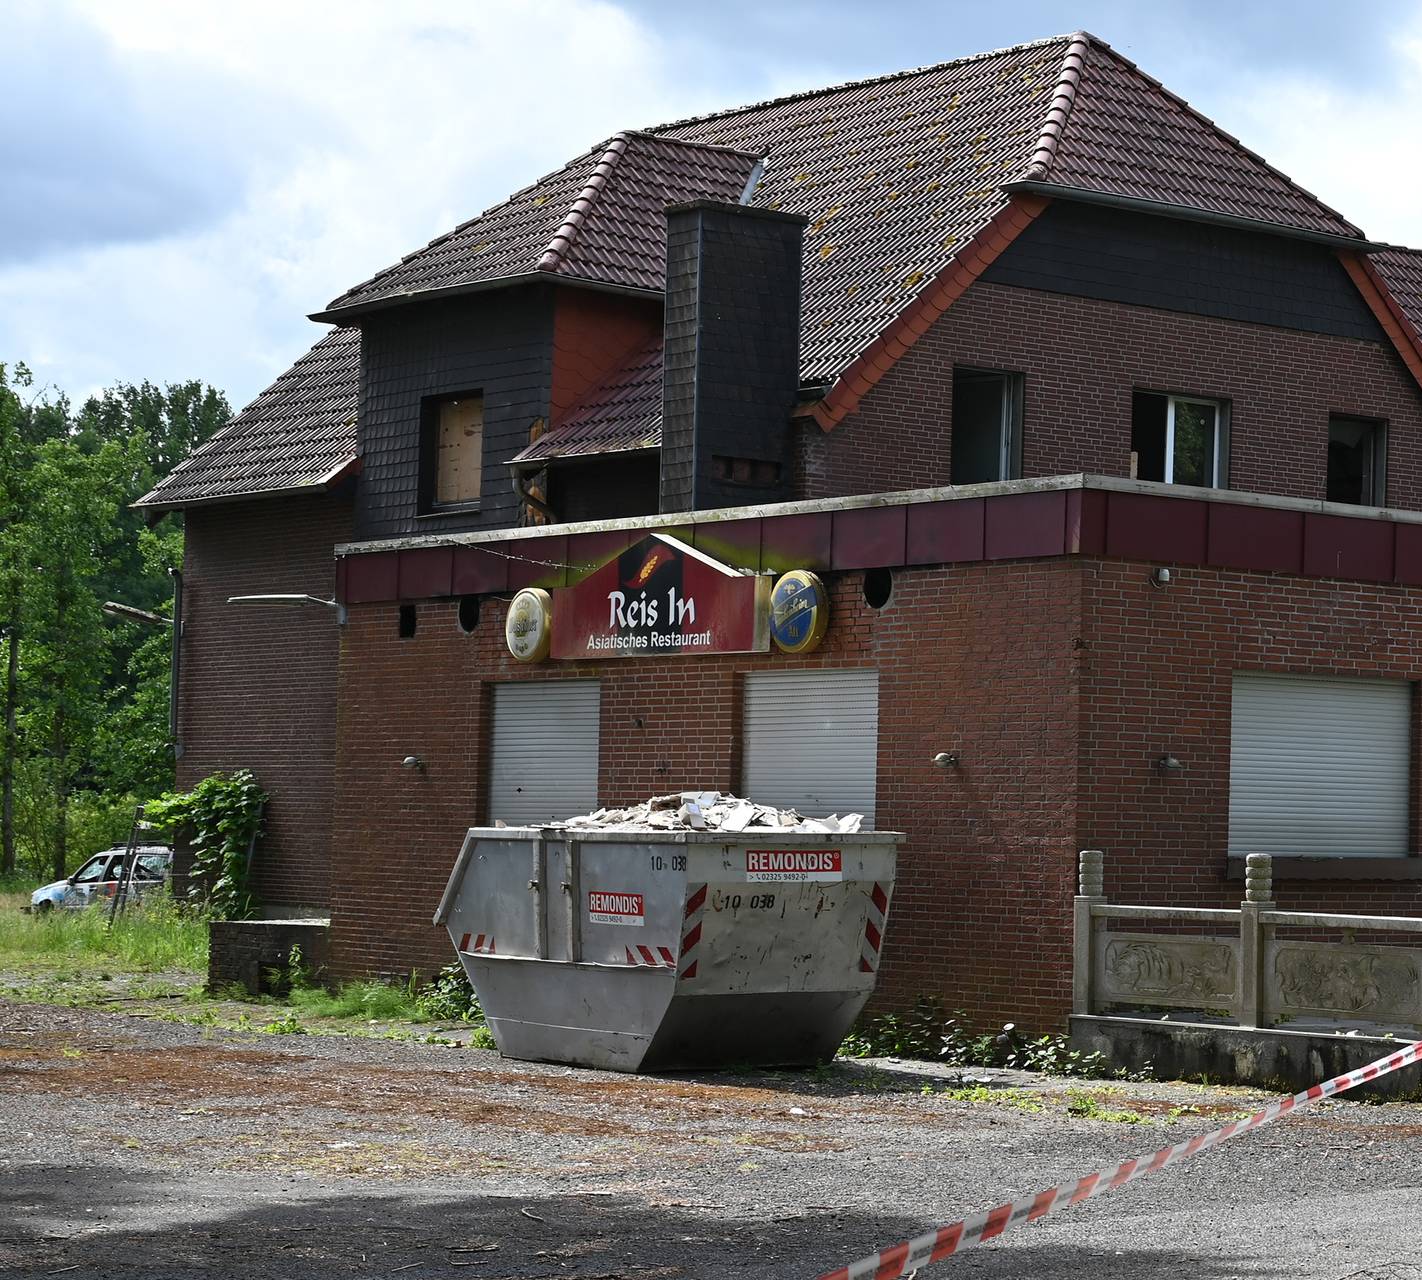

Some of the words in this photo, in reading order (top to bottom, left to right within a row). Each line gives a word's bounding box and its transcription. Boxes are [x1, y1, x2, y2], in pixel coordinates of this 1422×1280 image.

[607, 590, 659, 629] Reis
[667, 586, 696, 626] In
[586, 632, 648, 650] Asiatisches
[650, 629, 711, 648] Restaurant
[761, 873, 783, 881] 02325
[750, 894, 775, 909] 038
